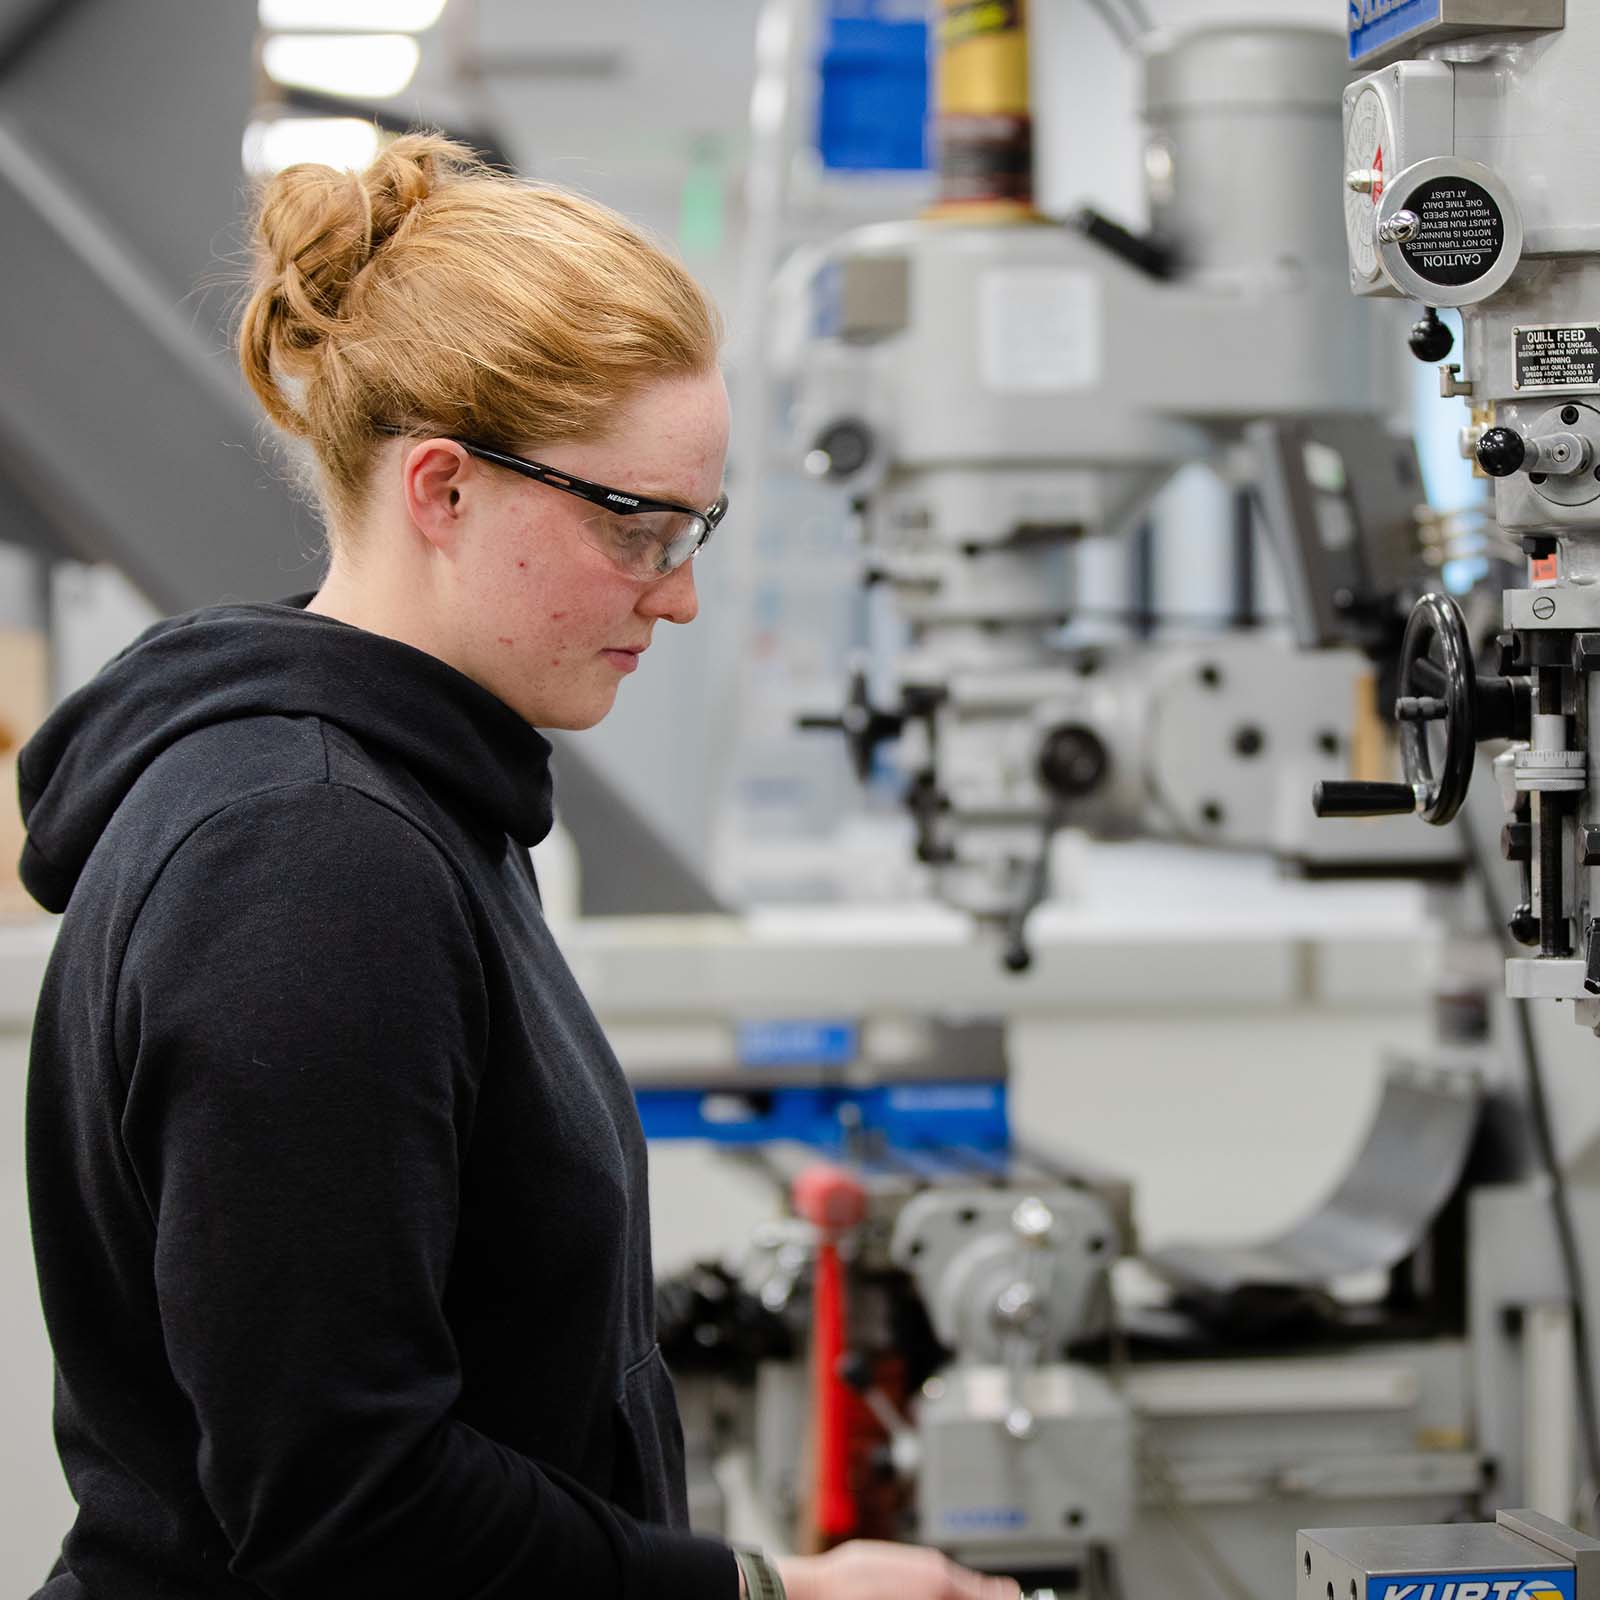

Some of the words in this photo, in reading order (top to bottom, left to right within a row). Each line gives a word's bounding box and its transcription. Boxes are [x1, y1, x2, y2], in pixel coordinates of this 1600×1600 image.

[1406, 242, 1437, 250] UNLESS
[1424, 254, 1481, 267] CAUTION
[1527, 332, 1554, 343] QUILL
[1557, 330, 1586, 341] FEED
[607, 493, 640, 507] NEMESIS
